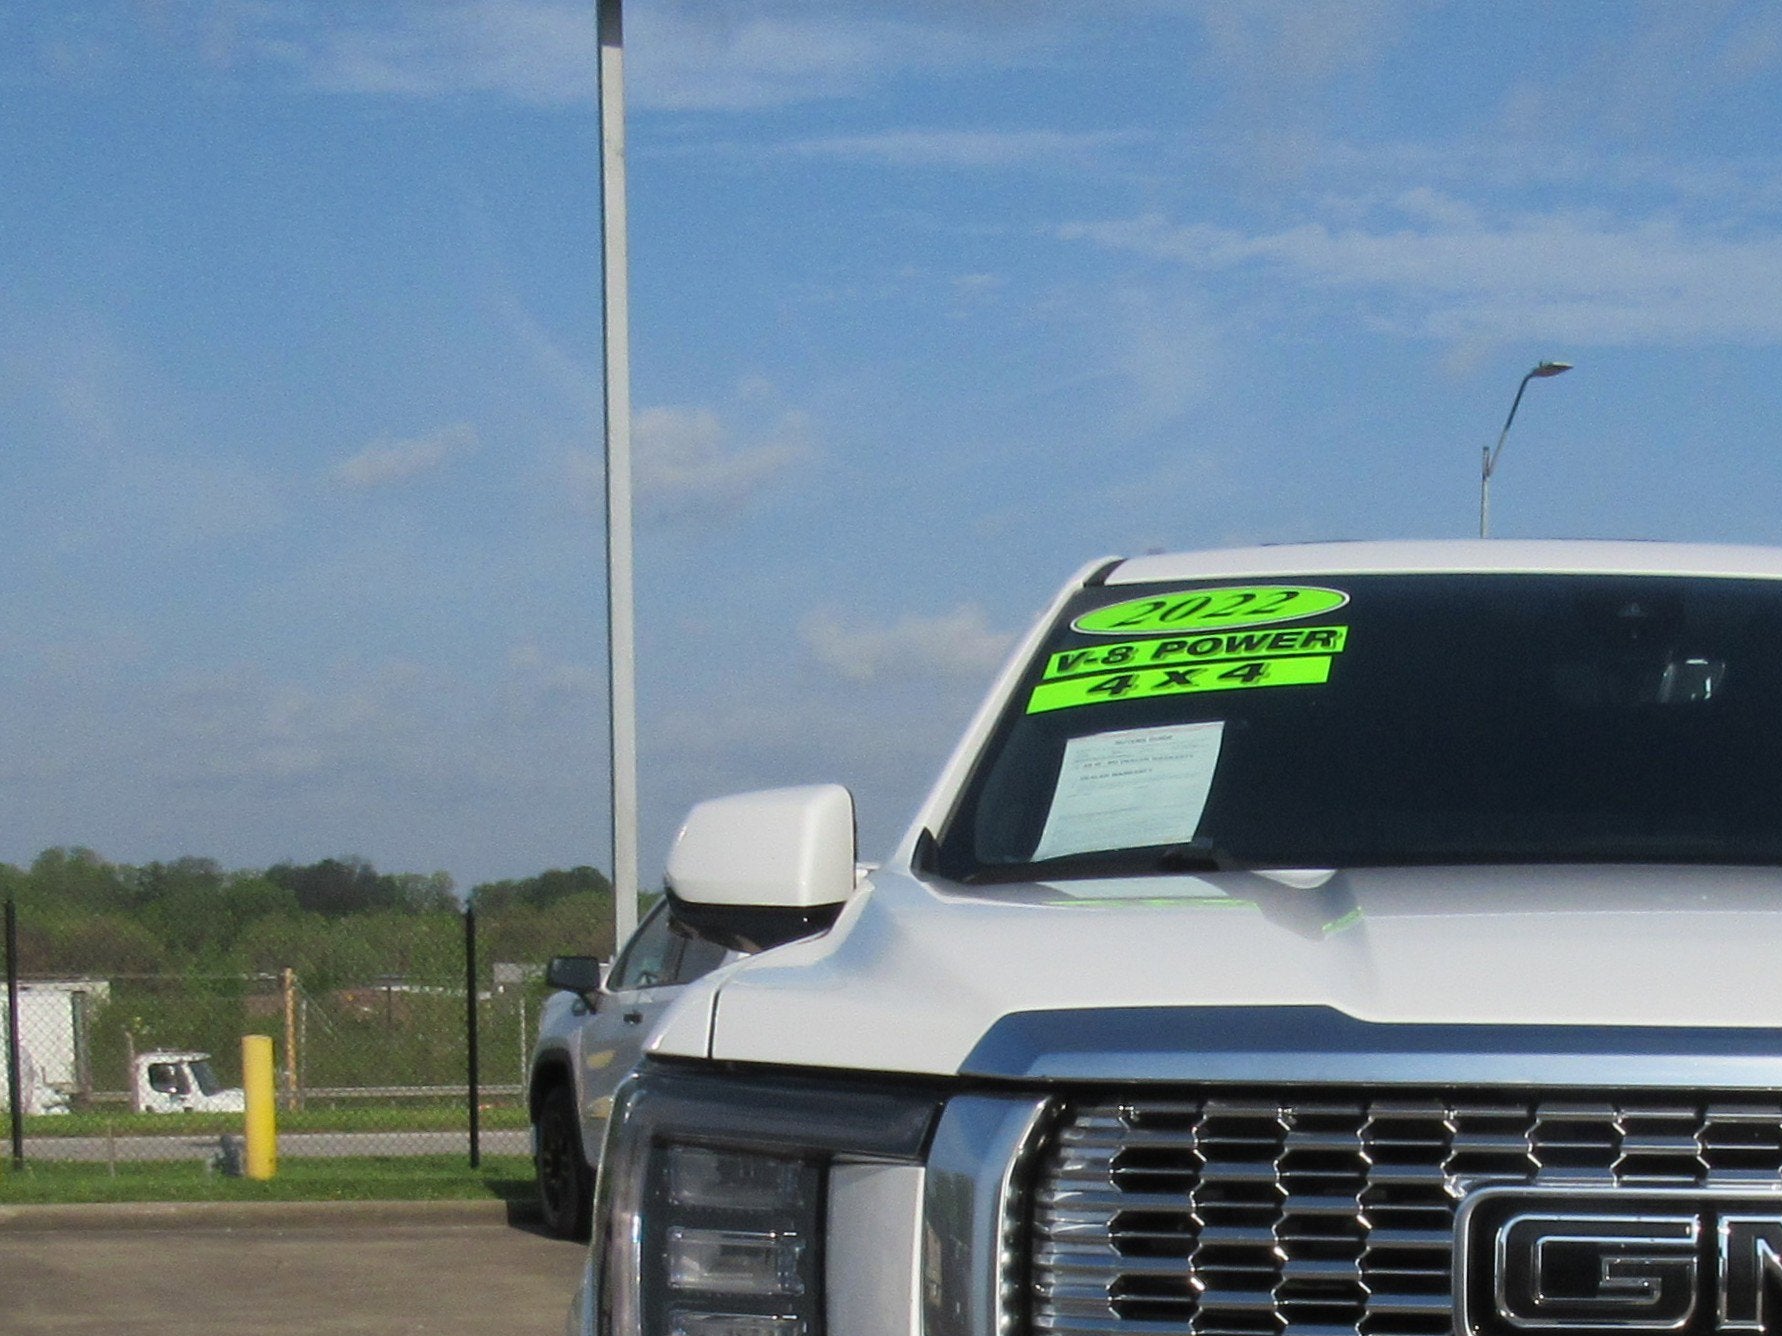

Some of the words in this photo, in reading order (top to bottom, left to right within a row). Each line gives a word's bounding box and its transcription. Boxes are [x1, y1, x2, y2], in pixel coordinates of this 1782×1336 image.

[1107, 590, 1300, 628] 2022
[1056, 645, 1137, 673] V-8
[1152, 629, 1343, 660] POWER
[1087, 673, 1138, 696] 4
[1217, 663, 1271, 684] 4
